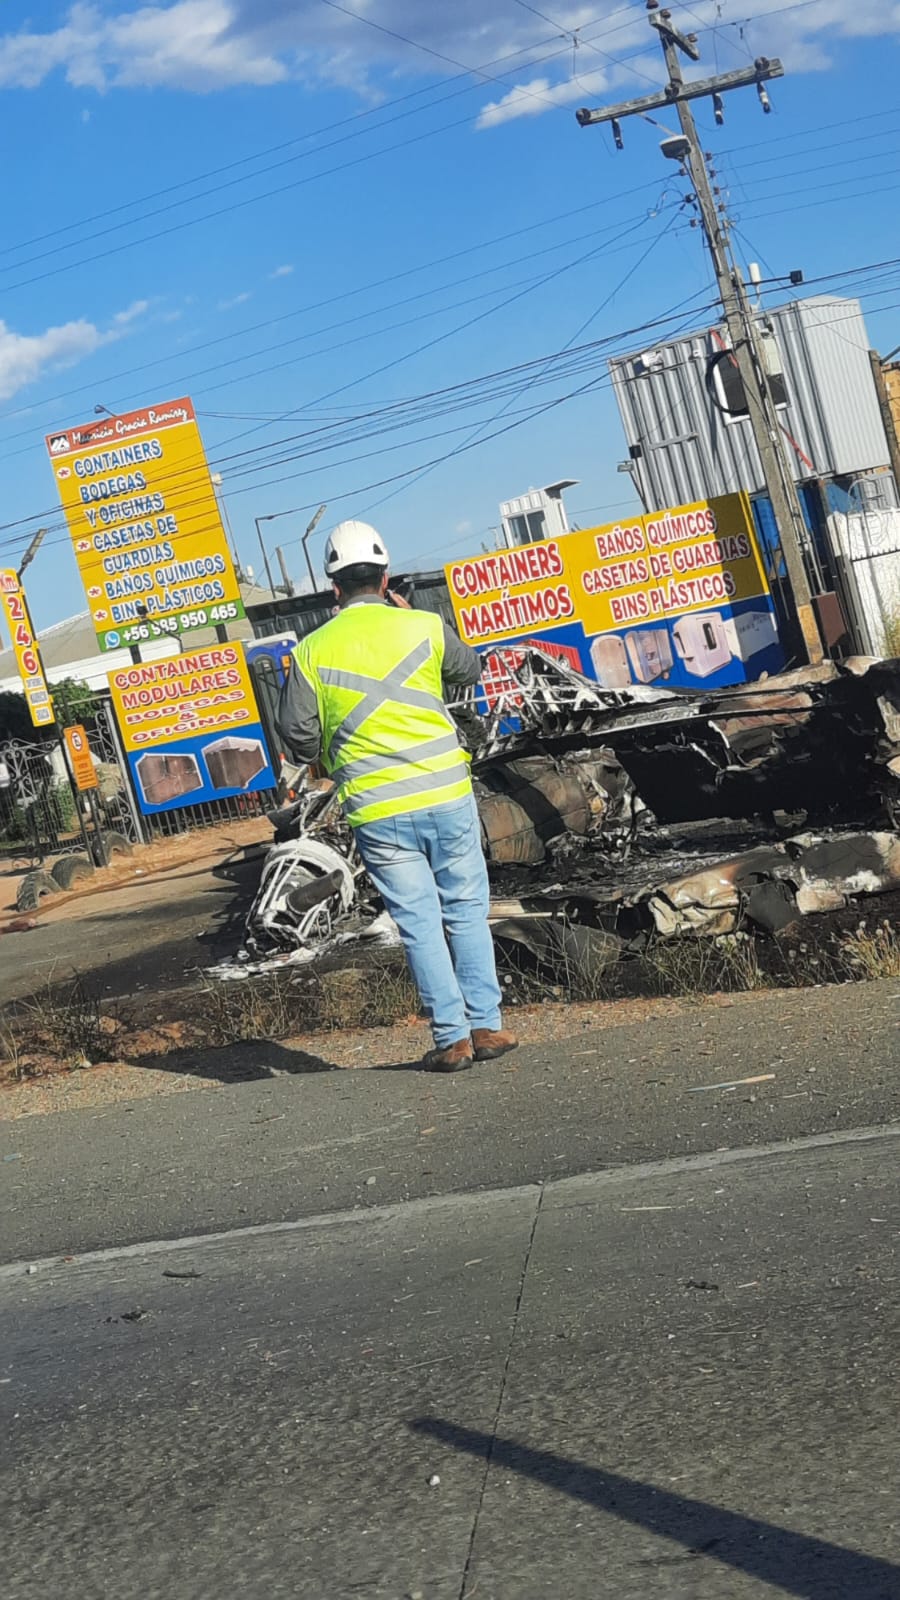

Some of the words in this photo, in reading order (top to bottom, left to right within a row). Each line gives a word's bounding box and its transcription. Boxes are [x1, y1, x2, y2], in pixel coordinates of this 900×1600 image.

[115, 418, 147, 435] Gracia
[74, 438, 163, 479] CONTAINERS
[80, 472, 148, 504] BODEGAS
[85, 508, 97, 528] Y
[99, 493, 165, 525] OFICINAS
[94, 522, 155, 553] CASETAS
[157, 516, 178, 535] DE
[595, 525, 645, 560] BAÑOS
[647, 510, 717, 548] QUÍMICOS
[103, 542, 174, 576] GUARDIAS
[105, 573, 154, 600] BAÑOS
[155, 555, 226, 586] QUÍMICOS
[451, 542, 563, 598] CONTAINERS
[582, 558, 649, 595] CASETAS
[650, 553, 673, 578] DE
[672, 534, 750, 573] GUARDIAS
[145, 581, 225, 614] PLÁSTICOS
[460, 584, 574, 639] MARÍTIMOS
[610, 593, 649, 622] BINS
[650, 571, 735, 614] PLÁSTICOS
[123, 625, 149, 641] +56
[180, 611, 208, 628] 950
[210, 603, 237, 621] 465
[115, 648, 238, 689] CONTAINERS
[121, 669, 241, 709] MODULARES
[126, 690, 245, 724] BODEGAS
[131, 709, 249, 743] OFICINAS
